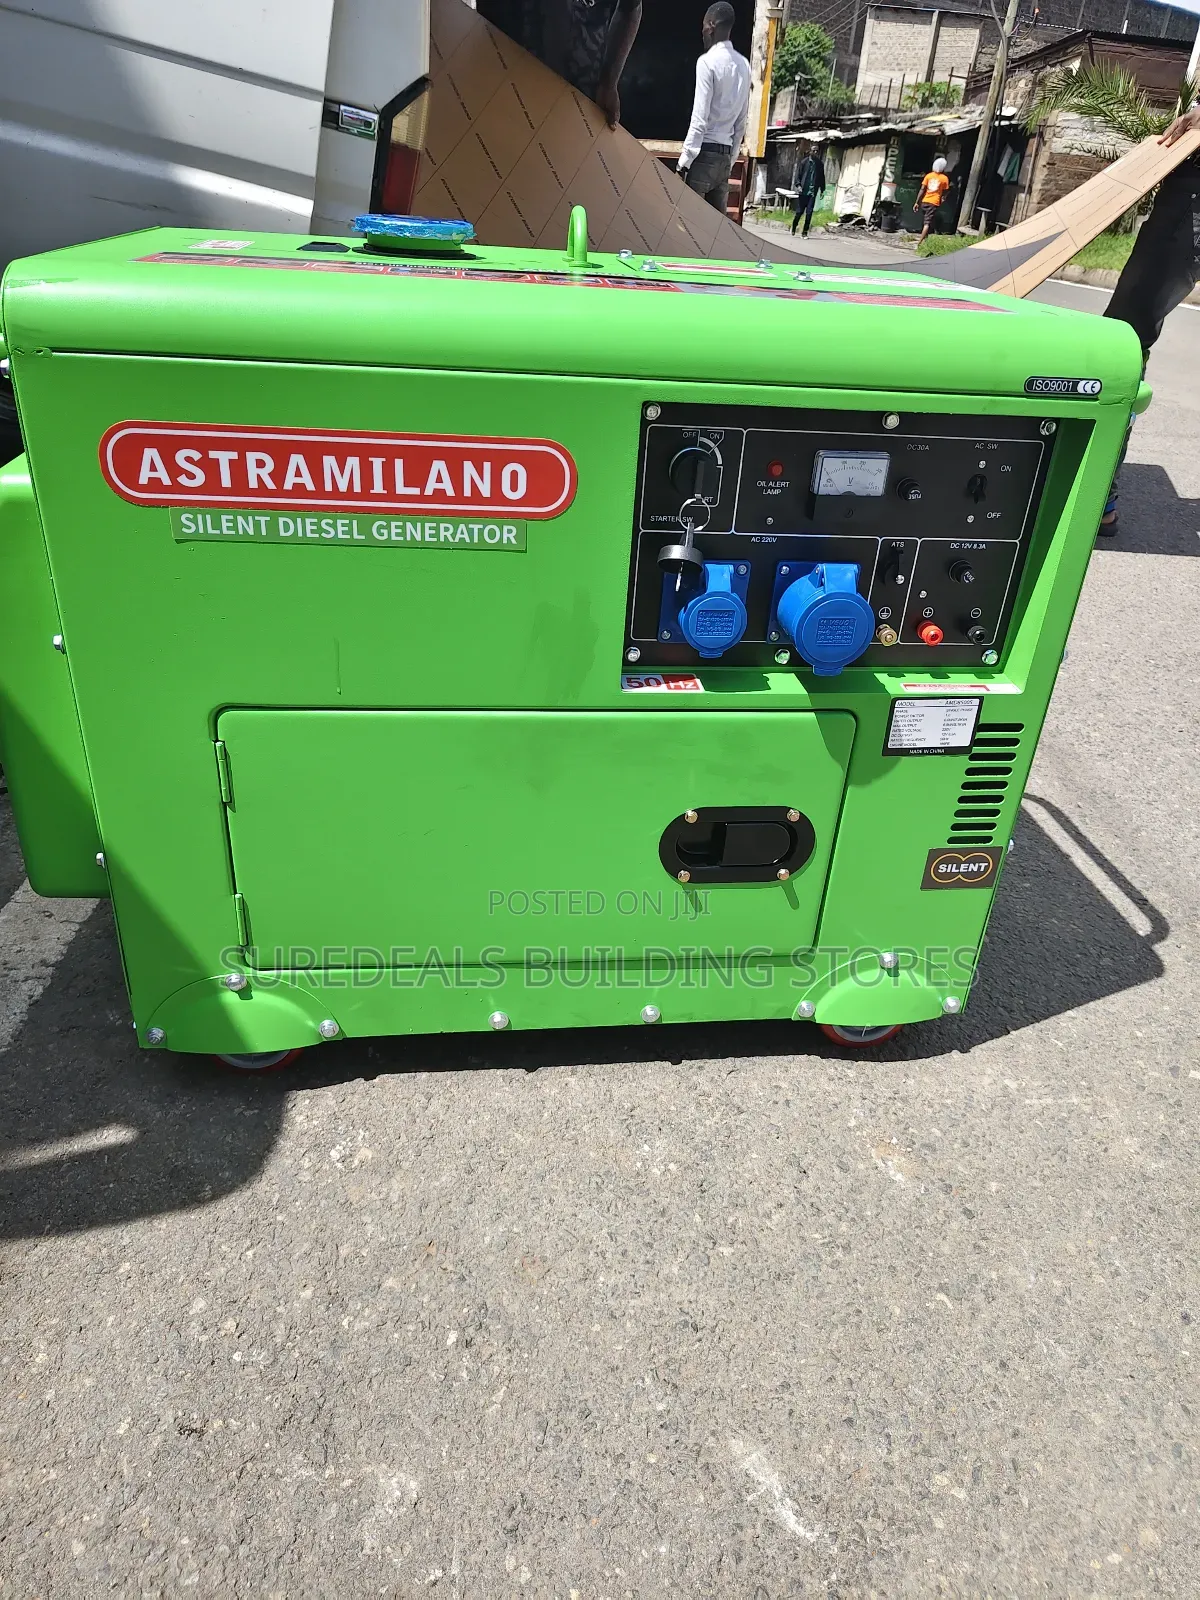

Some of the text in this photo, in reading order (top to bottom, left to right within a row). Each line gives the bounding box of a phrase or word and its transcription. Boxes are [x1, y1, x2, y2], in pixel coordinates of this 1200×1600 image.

[1032, 380, 1072, 392] ISO9001
[138, 447, 528, 500] ASTRAMILANO
[180, 514, 518, 545] SILENT DIESEL GENERATOR
[626, 677, 661, 688] 50
[938, 862, 988, 873] SILENT
